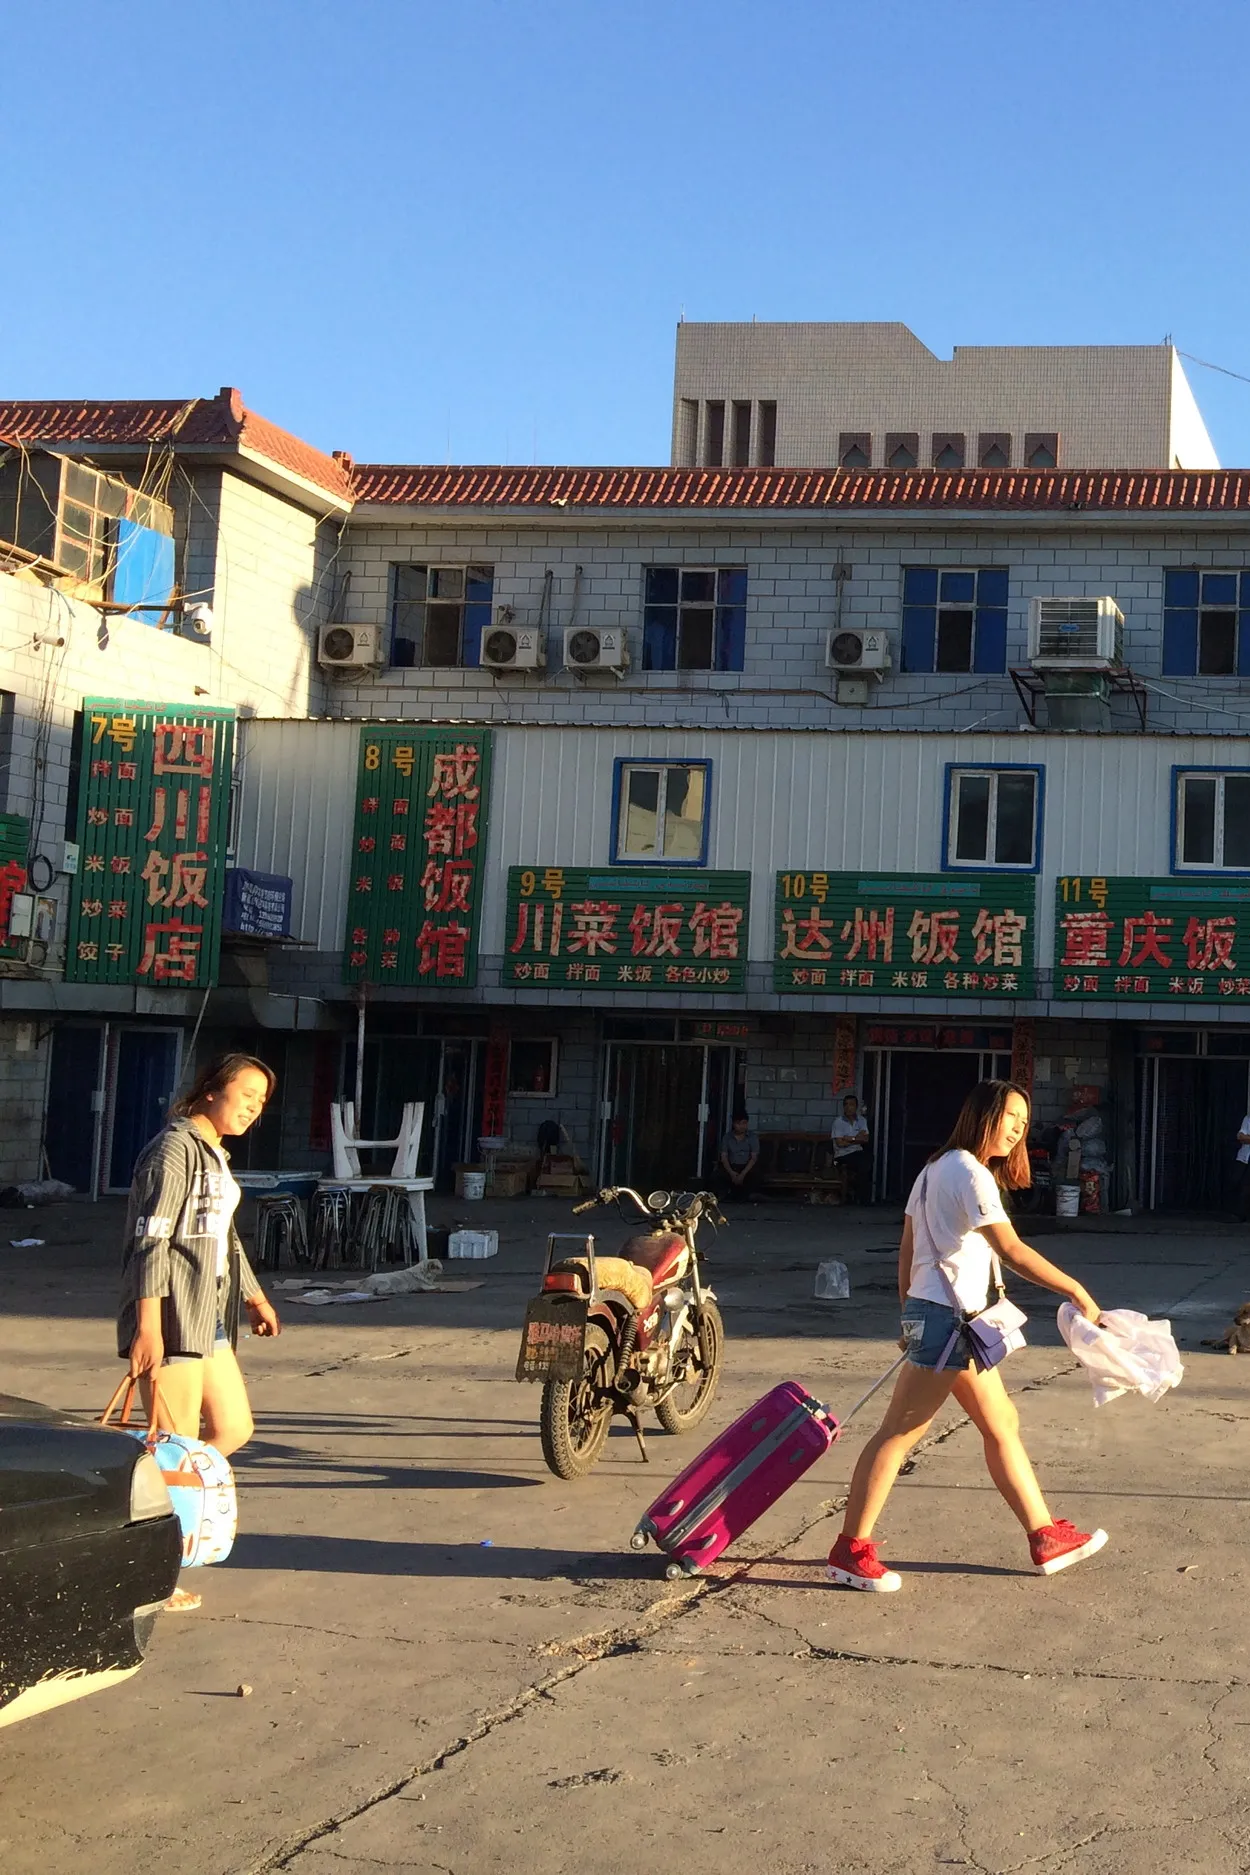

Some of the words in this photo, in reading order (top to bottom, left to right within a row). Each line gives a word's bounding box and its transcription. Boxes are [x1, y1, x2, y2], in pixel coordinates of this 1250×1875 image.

[91, 716, 138, 752] 7号
[364, 744, 416, 777] 8号
[87, 806, 135, 827] 炒面
[84, 854, 132, 875] 米饭
[136, 723, 213, 981] 四川饭店
[415, 743, 480, 978] 成都饭馆
[355, 873, 404, 893] 米饭
[519, 868, 566, 899] 9号
[780, 872, 830, 905] 10号
[1060, 877, 1109, 909] 11号
[81, 898, 129, 919] 炒菜
[509, 899, 743, 960] 川菜饭馆
[779, 906, 1028, 968] 达州饭馆
[77, 941, 127, 961] 饺子
[514, 962, 551, 981] 炒面
[664, 964, 731, 985] 各色小炒
[791, 968, 828, 986] 炒面
[839, 969, 876, 988] 拌面
[891, 970, 929, 989] 米饭
[943, 971, 1019, 992] 各种炒菜
[1063, 974, 1100, 993] 炒面
[1168, 976, 1205, 995] 米饭
